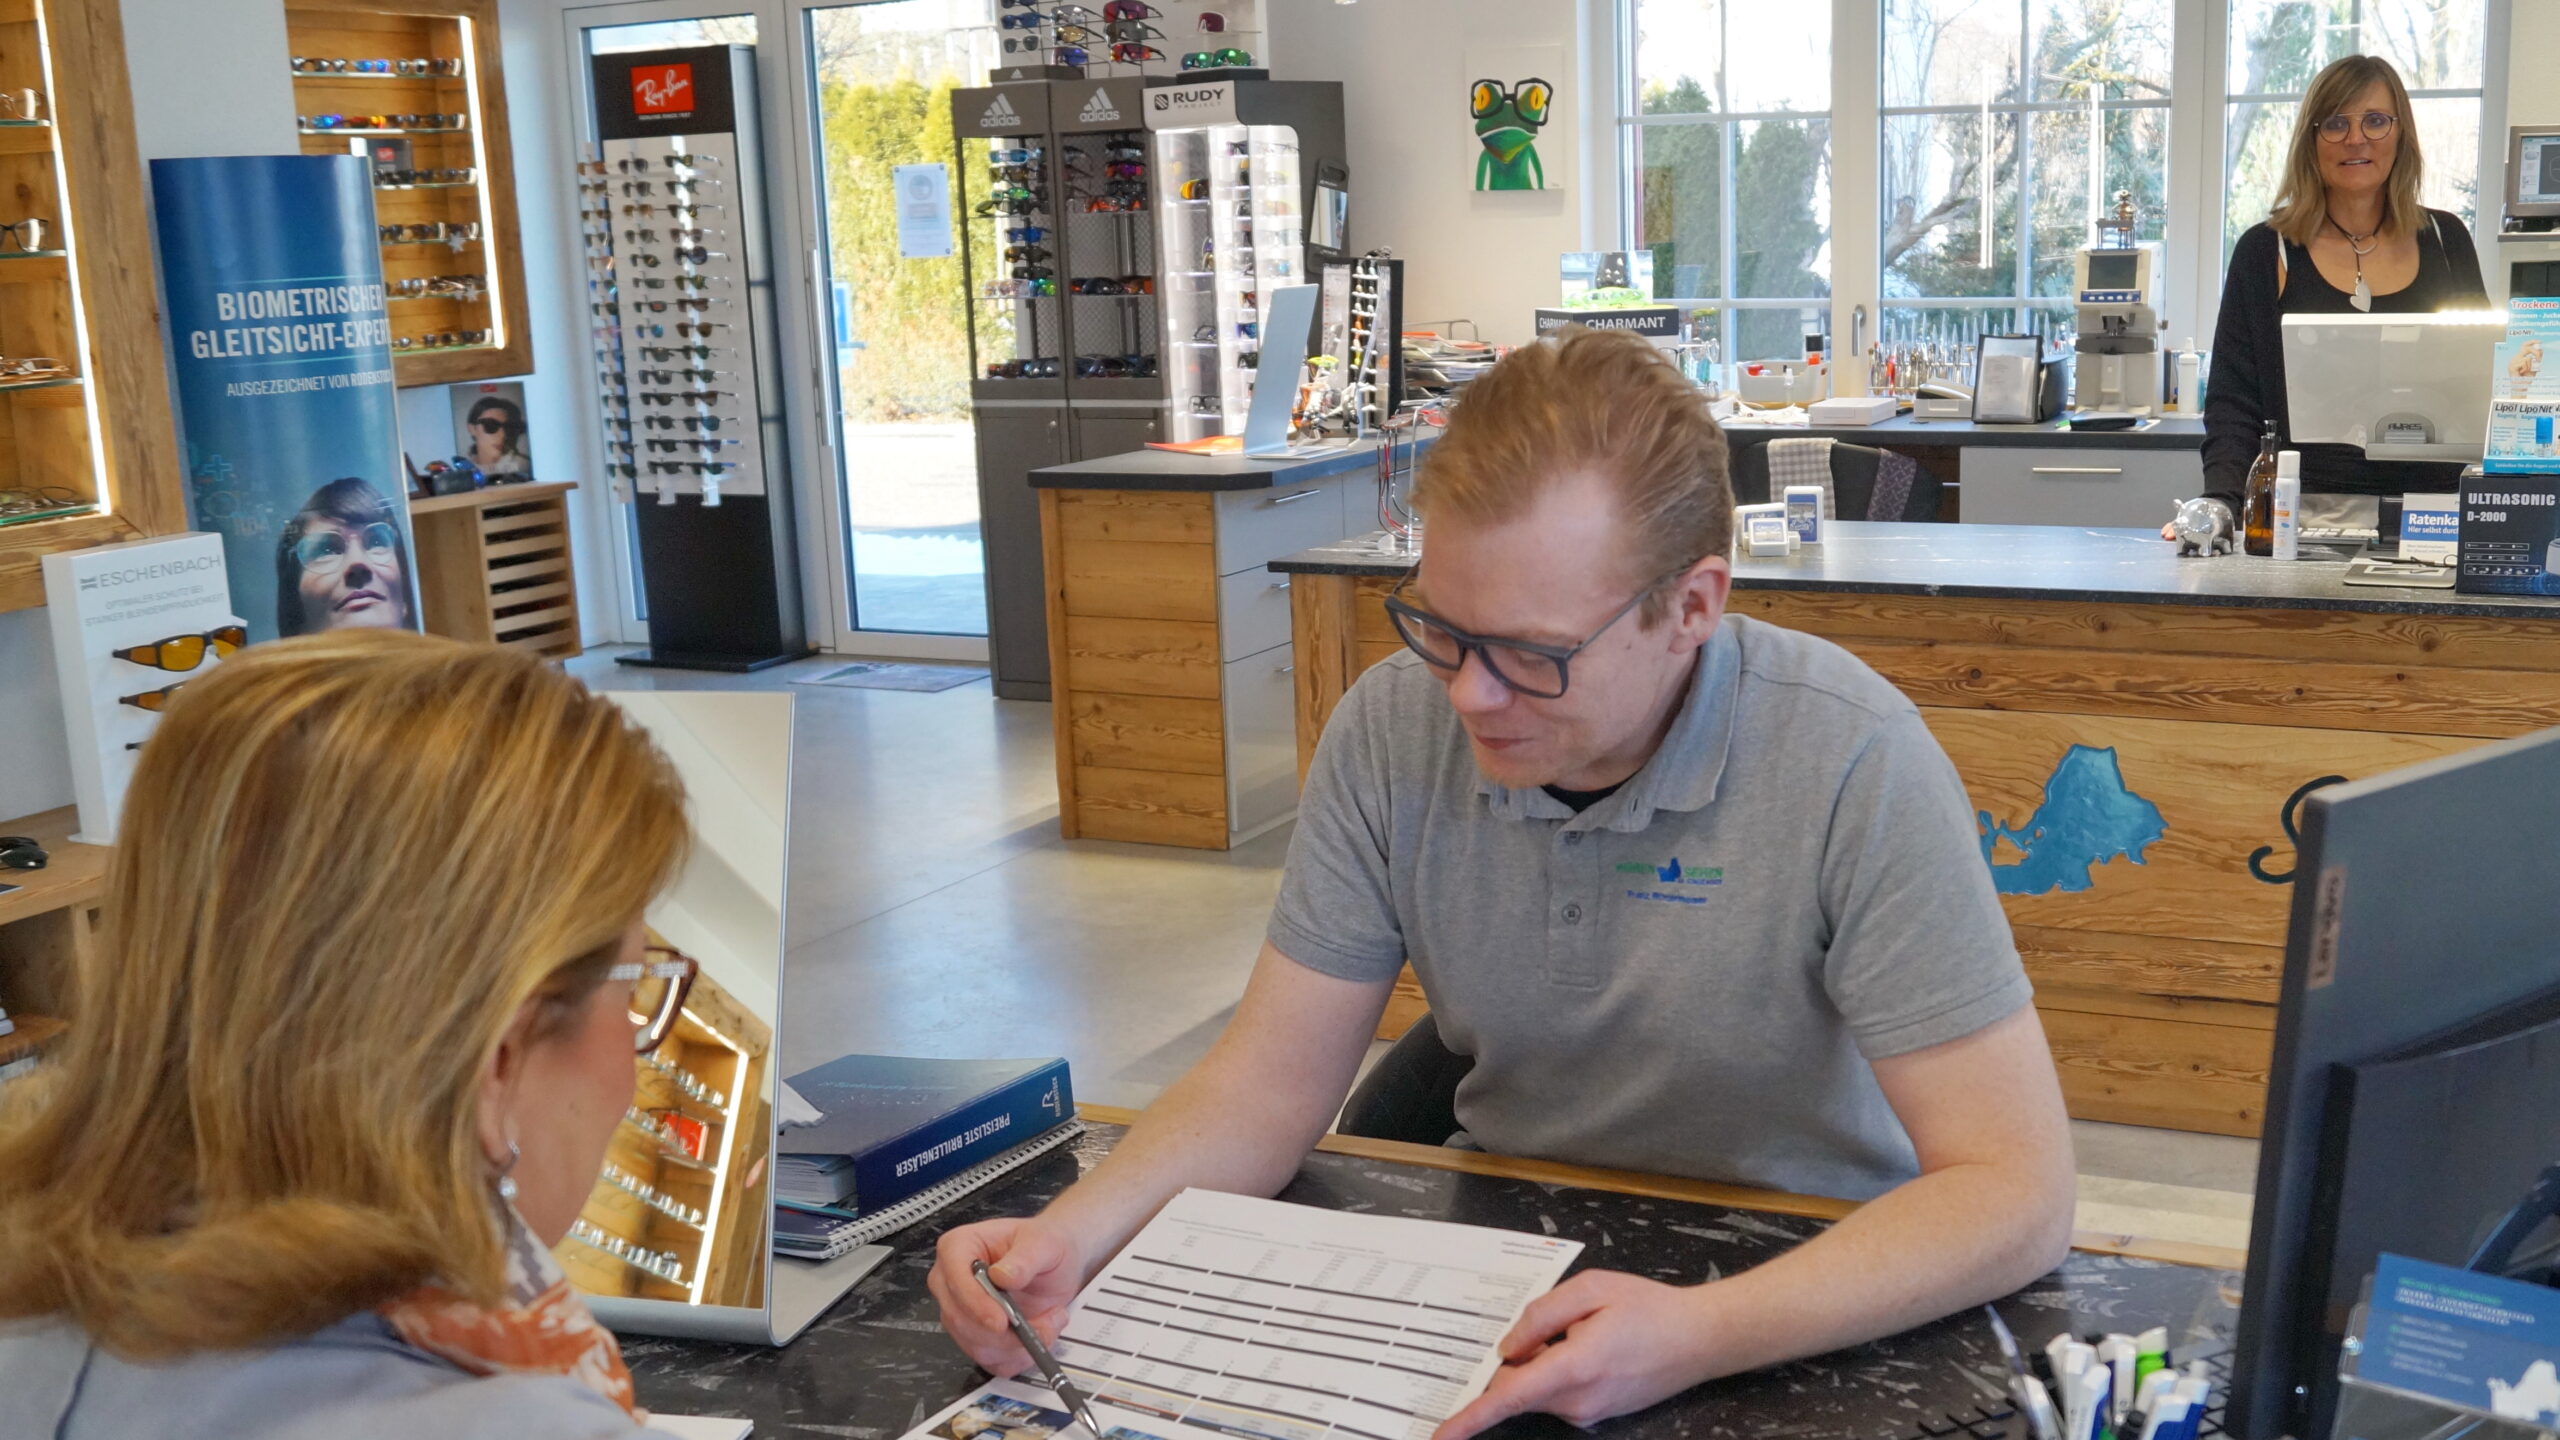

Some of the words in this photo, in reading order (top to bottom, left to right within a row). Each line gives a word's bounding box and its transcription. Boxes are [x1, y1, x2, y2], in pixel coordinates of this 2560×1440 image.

[1173, 88, 1225, 103] RUDY
[980, 115, 1021, 128] adidas
[1080, 108, 1120, 122] adidas
[216, 284, 384, 321] BIOMETRISCHER
[2511, 301, 2558, 309] Trockene
[1586, 316, 1666, 331] CHARMANT
[227, 376, 326, 397] AUSGEZEICHNET
[328, 374, 349, 388] VON
[2468, 493, 2556, 506] ULTRASONIC
[2409, 513, 2459, 526] Ratenka
[2467, 511, 2507, 522] D-2000
[2422, 526, 2441, 534] selbst
[100, 555, 222, 588] ESCHENBACH
[963, 1112, 1010, 1145] PREISLISTE
[896, 1134, 963, 1177] BRILLENGLÄSER
